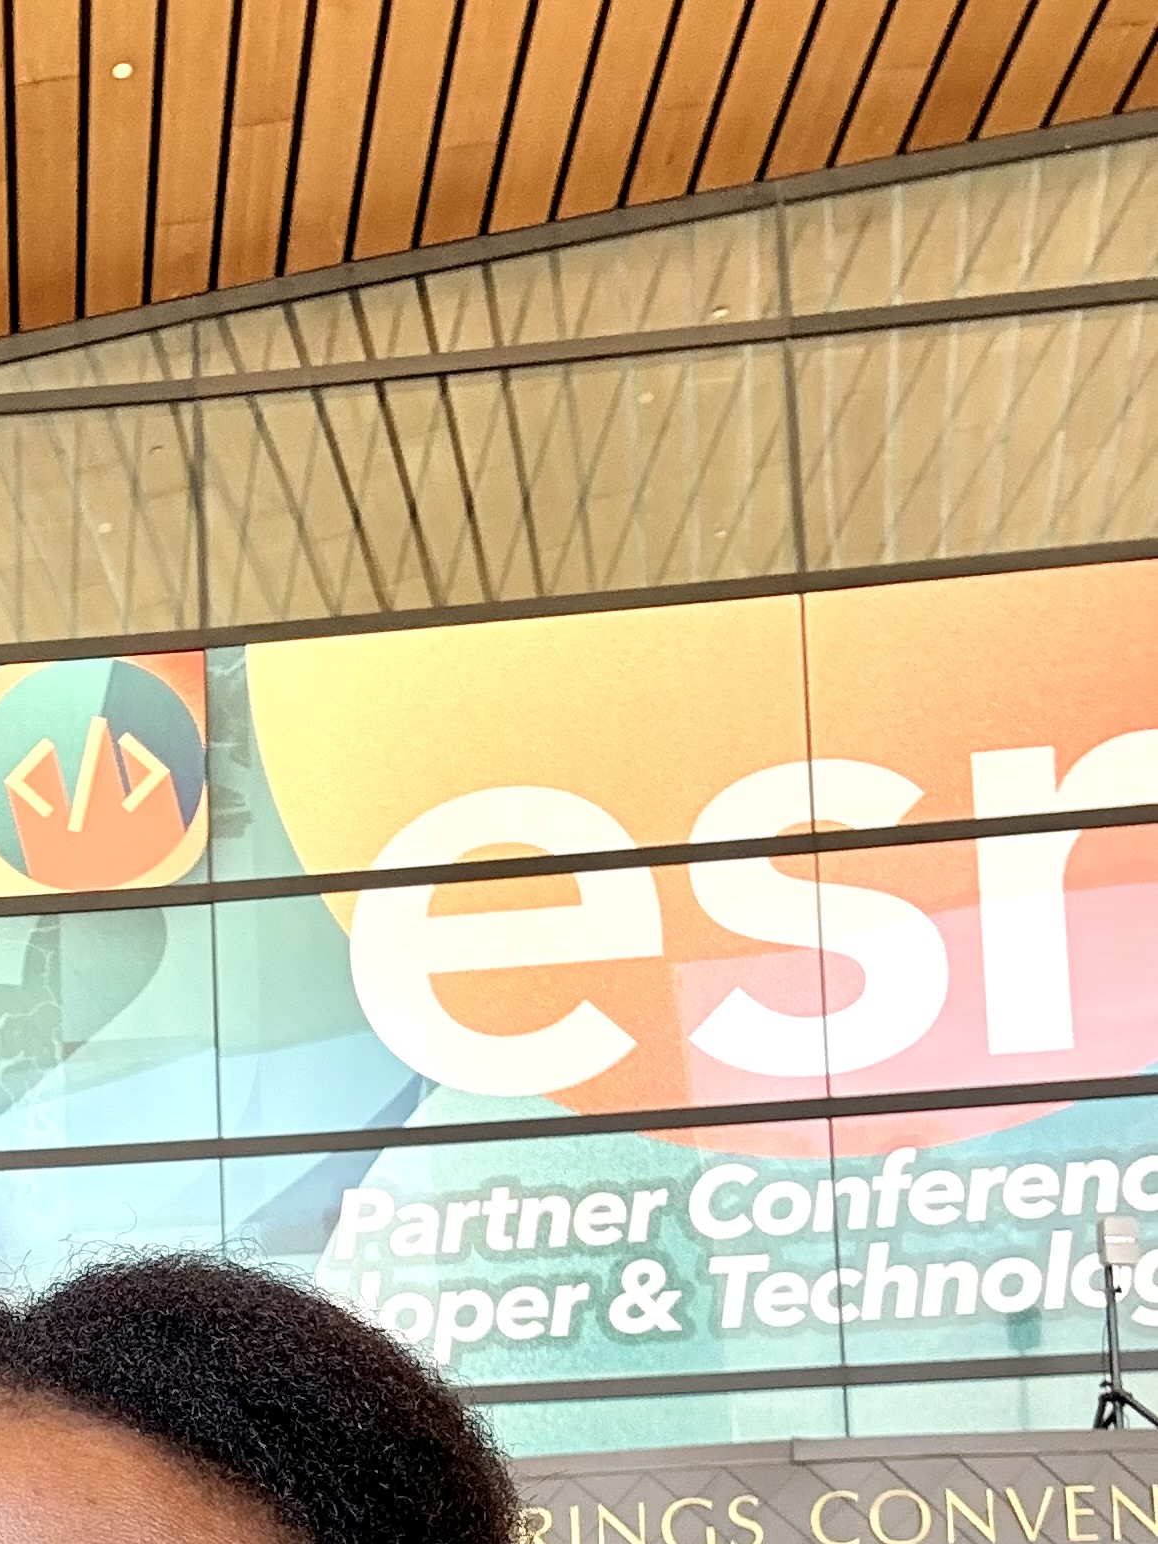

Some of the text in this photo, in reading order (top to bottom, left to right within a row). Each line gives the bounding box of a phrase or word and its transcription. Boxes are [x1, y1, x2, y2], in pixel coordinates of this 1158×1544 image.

[334, 1146, 1158, 1260] Partner Conferenc
[608, 1258, 682, 1335] &
